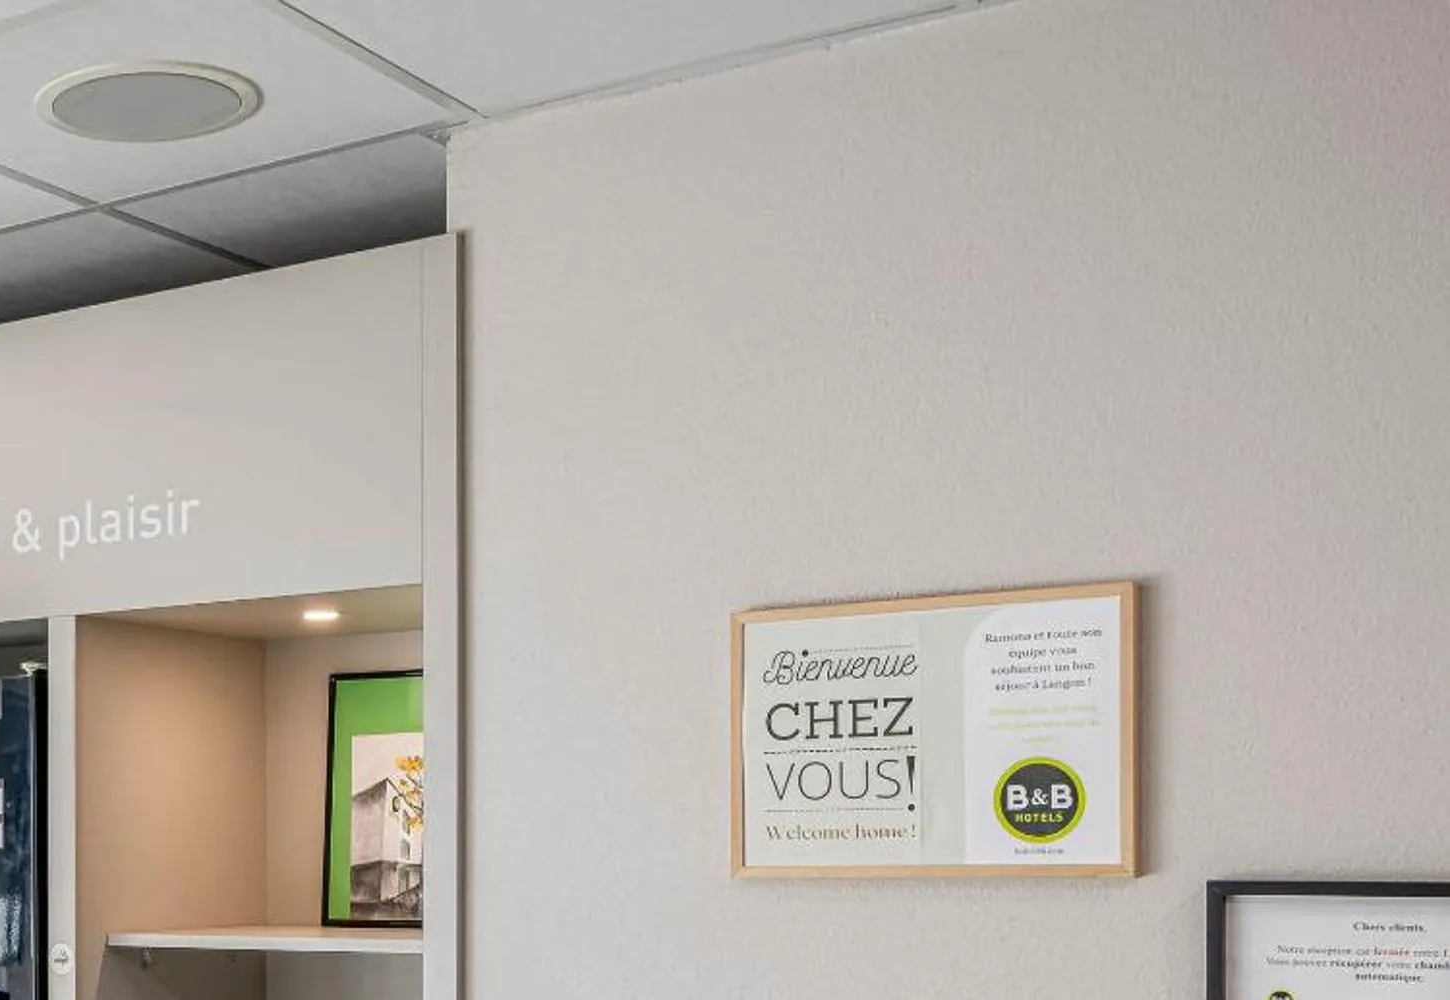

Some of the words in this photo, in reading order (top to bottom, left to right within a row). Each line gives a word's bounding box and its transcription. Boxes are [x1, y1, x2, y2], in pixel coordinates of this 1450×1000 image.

[12, 508, 42, 553] &
[59, 489, 200, 561] plaisir
[763, 650, 918, 685] Bienvenue
[766, 697, 914, 741] CHEZ
[766, 756, 916, 812] VOUS!
[1006, 783, 1074, 811] B&B
[765, 824, 851, 841] Welcome
[1014, 813, 1064, 823] HOTELS
[1353, 921, 1386, 933] Chers
